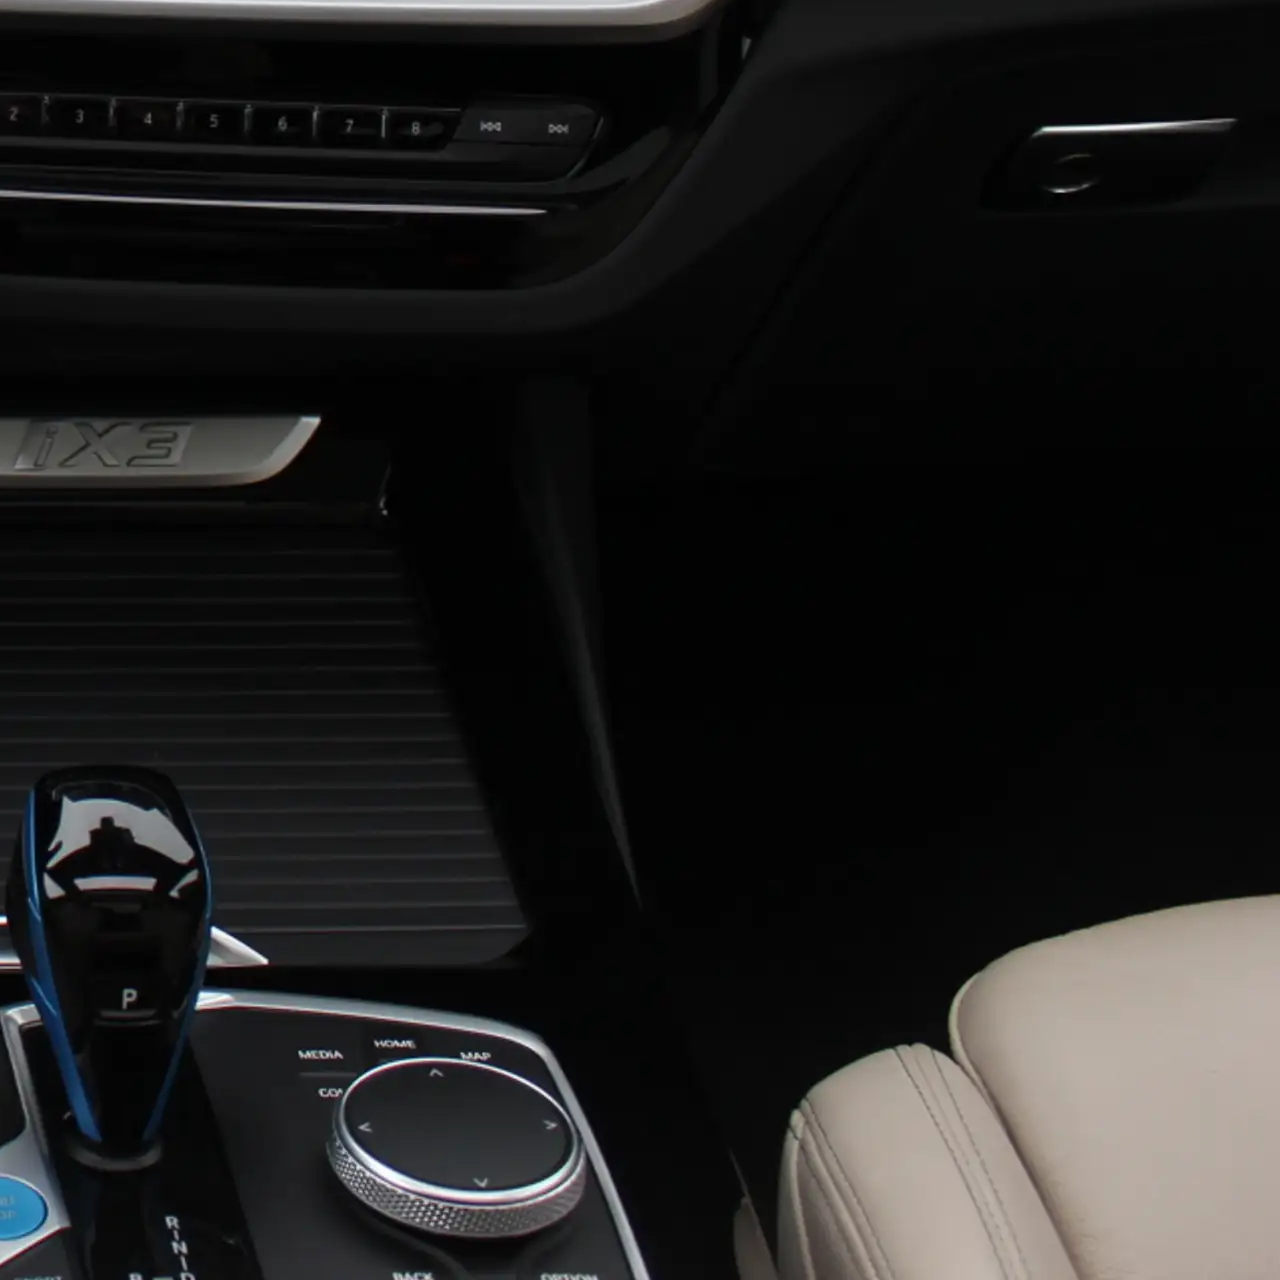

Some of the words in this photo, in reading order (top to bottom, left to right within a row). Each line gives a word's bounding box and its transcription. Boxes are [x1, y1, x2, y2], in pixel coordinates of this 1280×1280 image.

[75, 109, 85, 123] 3
[29, 420, 194, 469] iX3
[122, 988, 138, 1009] P
[374, 1039, 417, 1049] HOME
[298, 1050, 344, 1060] MEDIA
[460, 1051, 491, 1062] MAP
[165, 1215, 181, 1230] R
[171, 1240, 189, 1256] N
